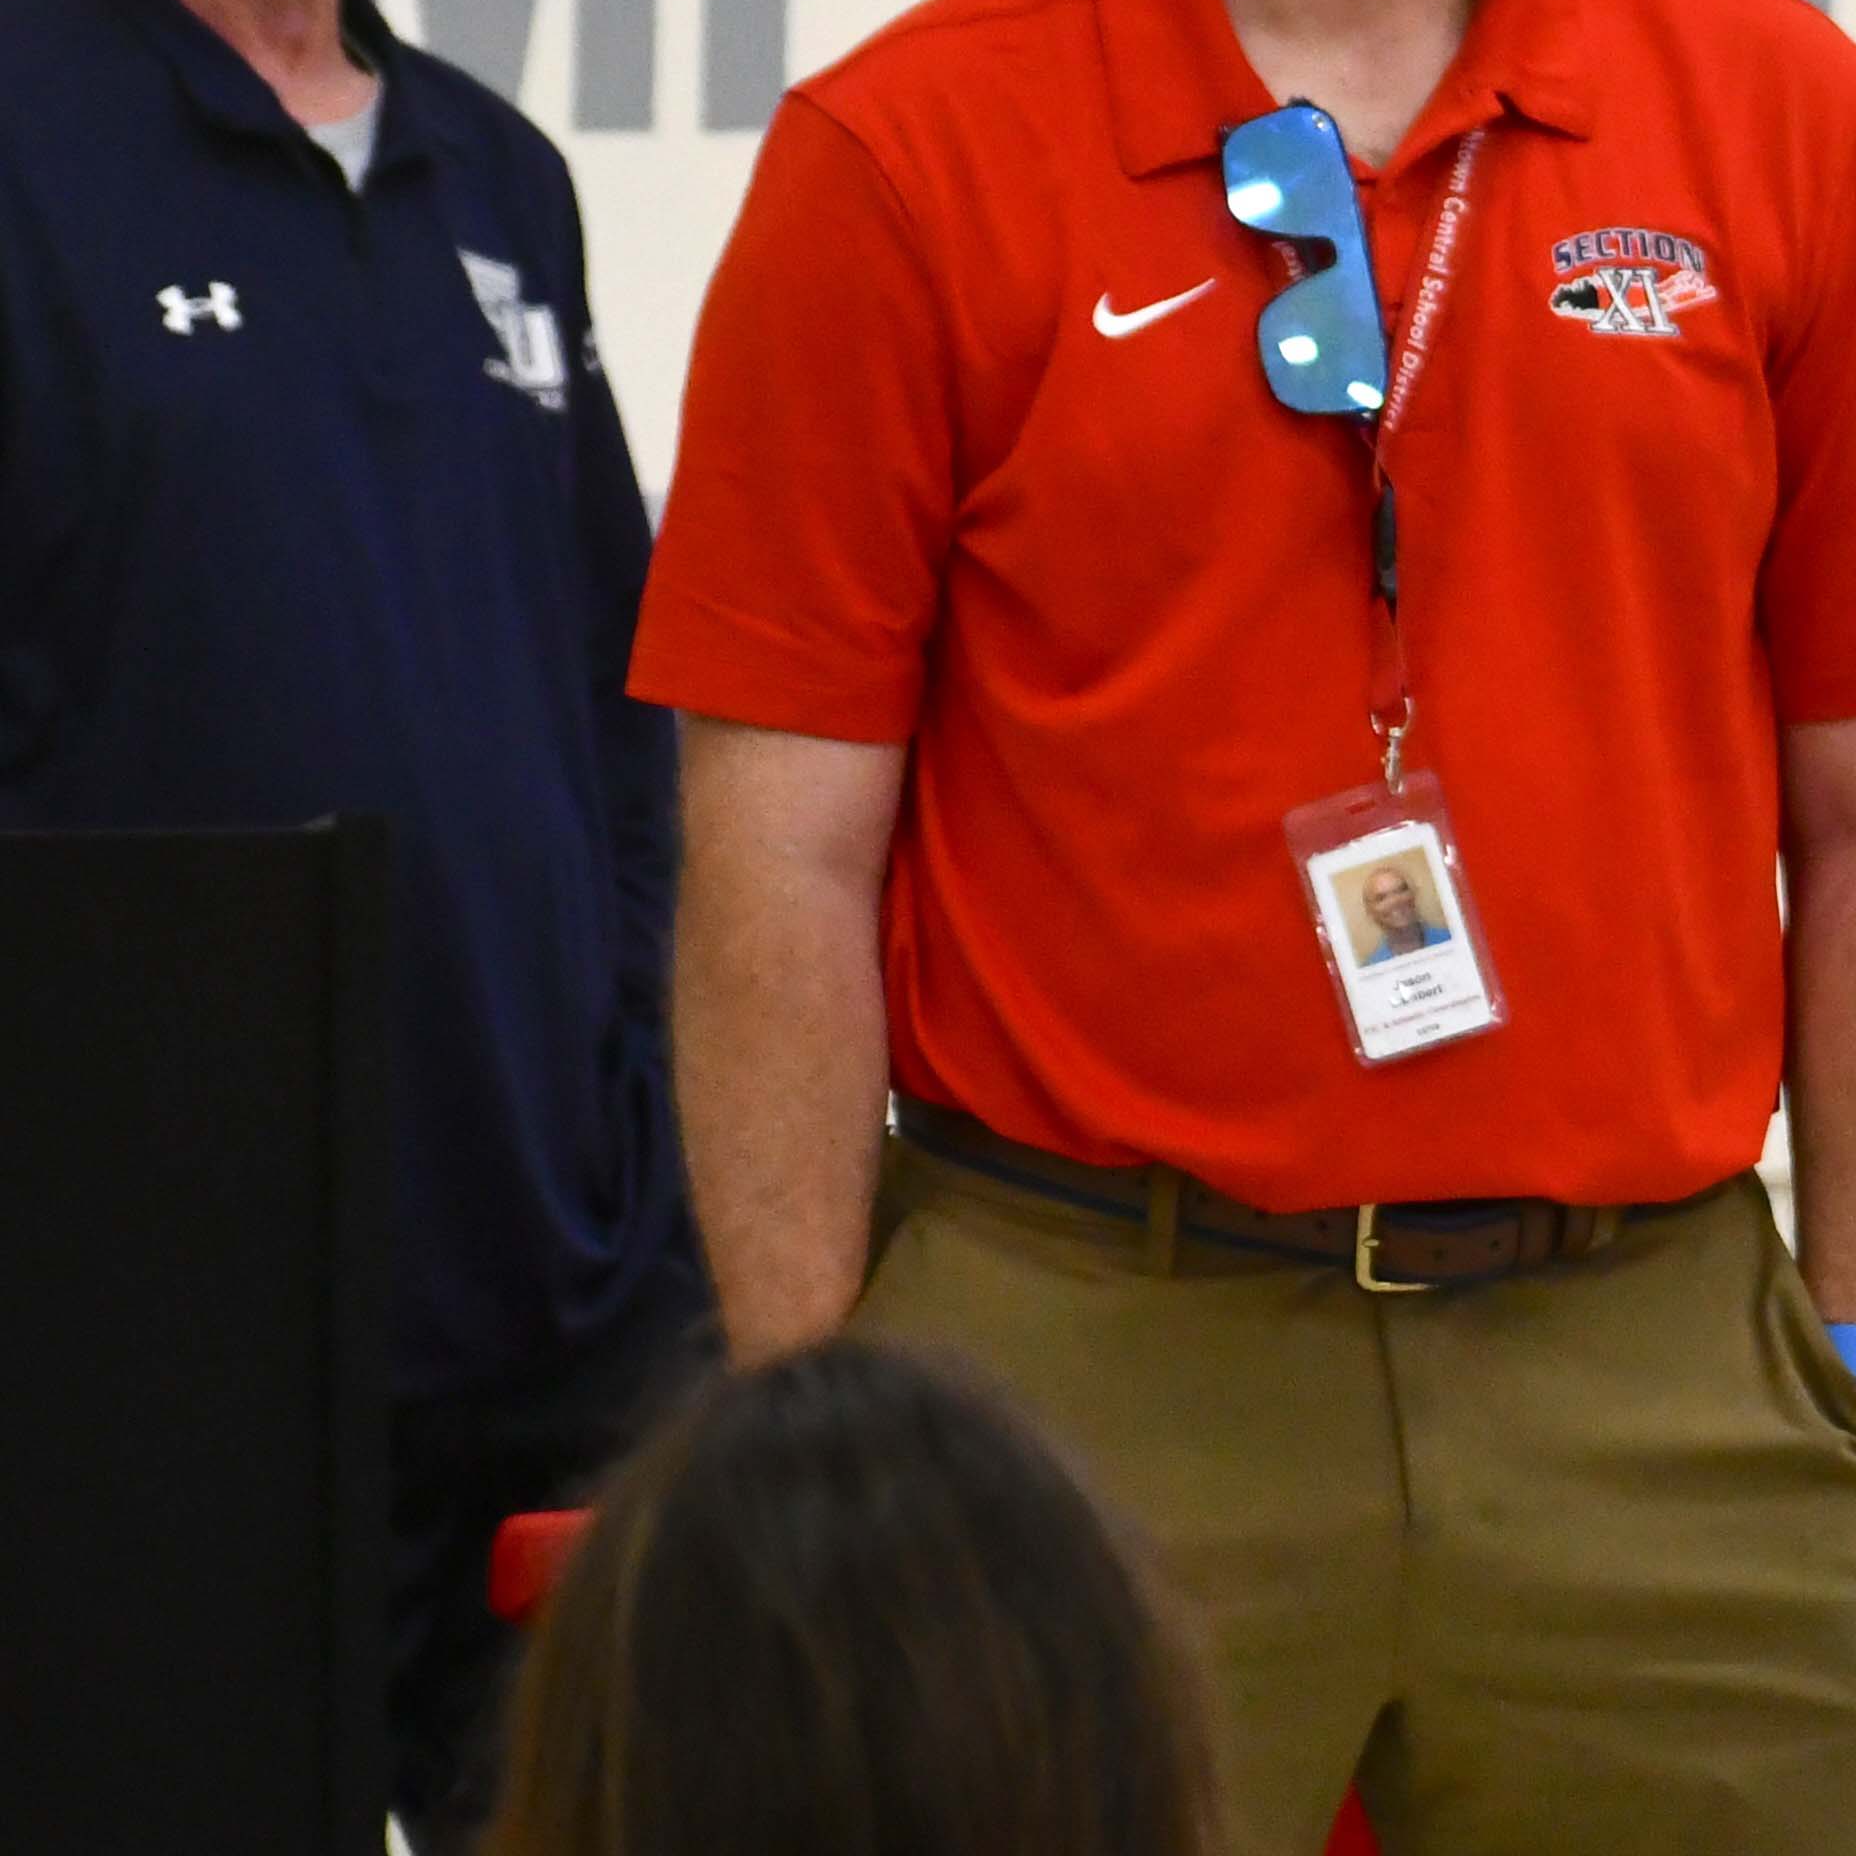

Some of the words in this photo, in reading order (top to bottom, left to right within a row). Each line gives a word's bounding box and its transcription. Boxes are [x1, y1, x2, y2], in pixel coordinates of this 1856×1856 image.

[1427, 196, 1466, 275] Central
[1552, 227, 1705, 276] SECTION
[1407, 276, 1445, 351] School
[1590, 266, 1681, 336] XI
